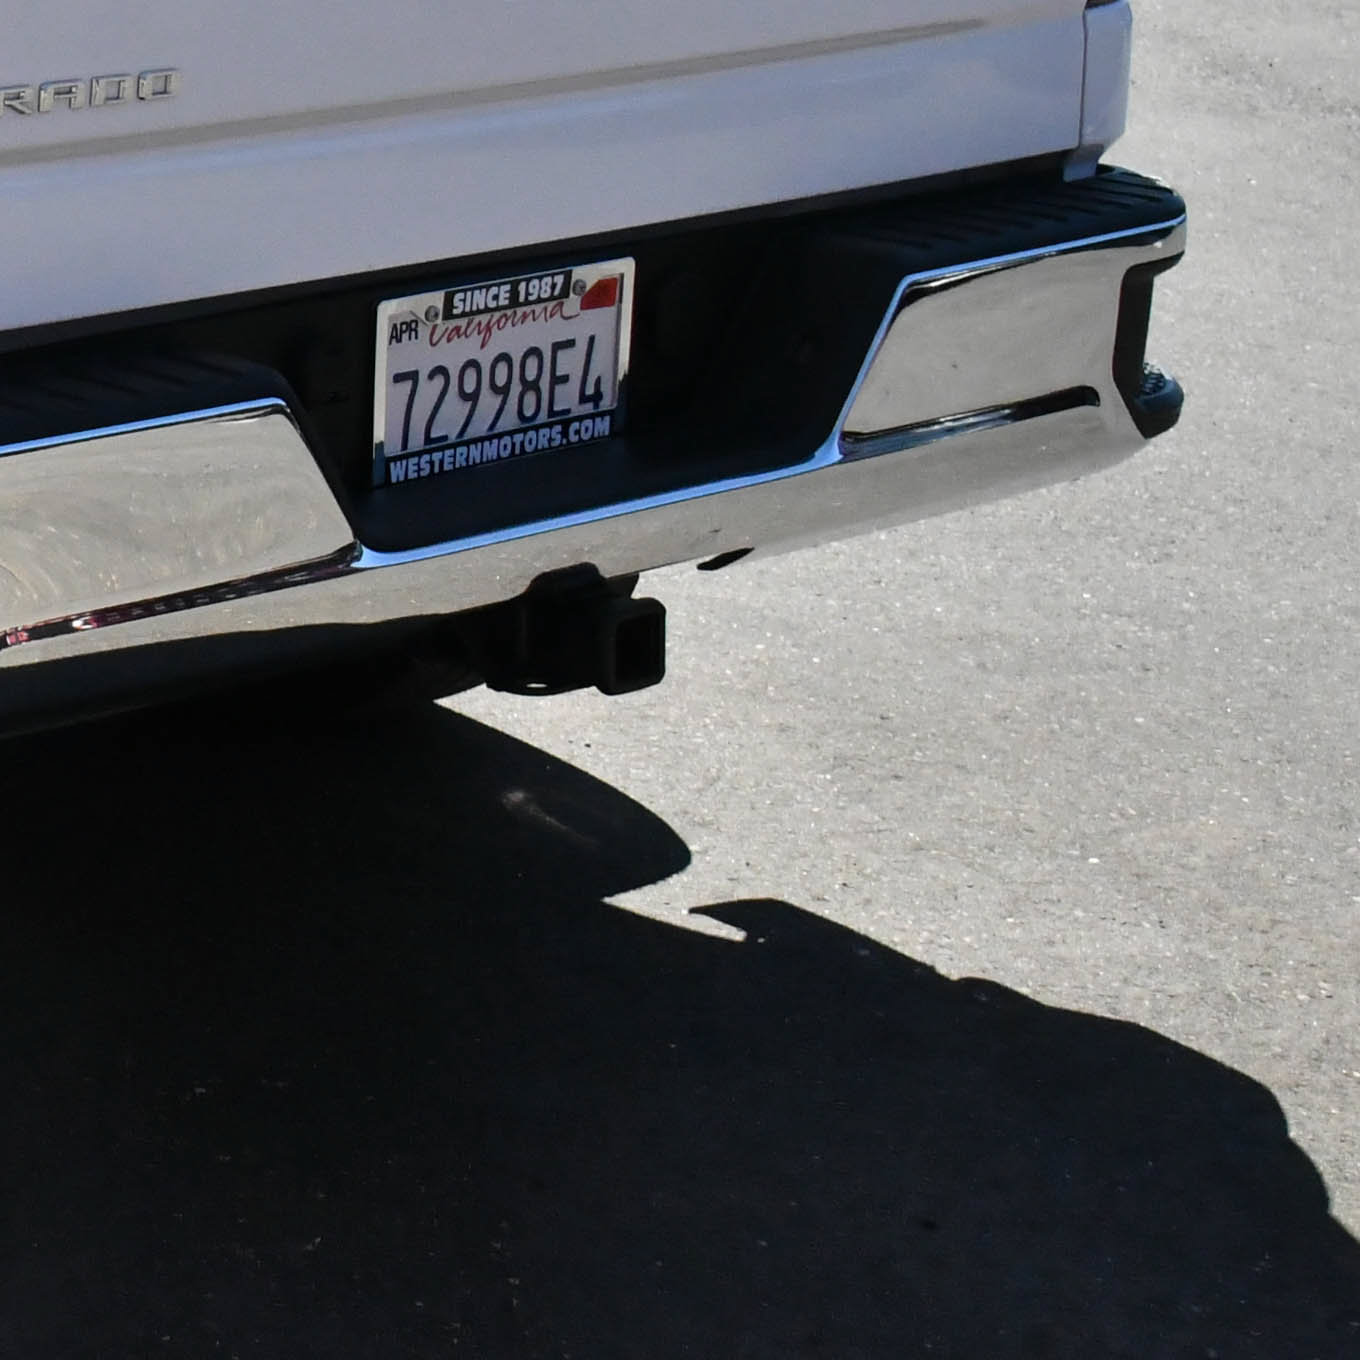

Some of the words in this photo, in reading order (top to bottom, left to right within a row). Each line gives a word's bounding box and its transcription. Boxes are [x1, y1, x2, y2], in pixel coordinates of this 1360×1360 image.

[452, 283, 510, 315] SINCE
[518, 273, 565, 302] 1987
[388, 319, 419, 345] APR
[429, 300, 579, 349] California
[392, 334, 604, 451] 72998E4
[389, 415, 611, 484] WESTERNMOTORS.COM
